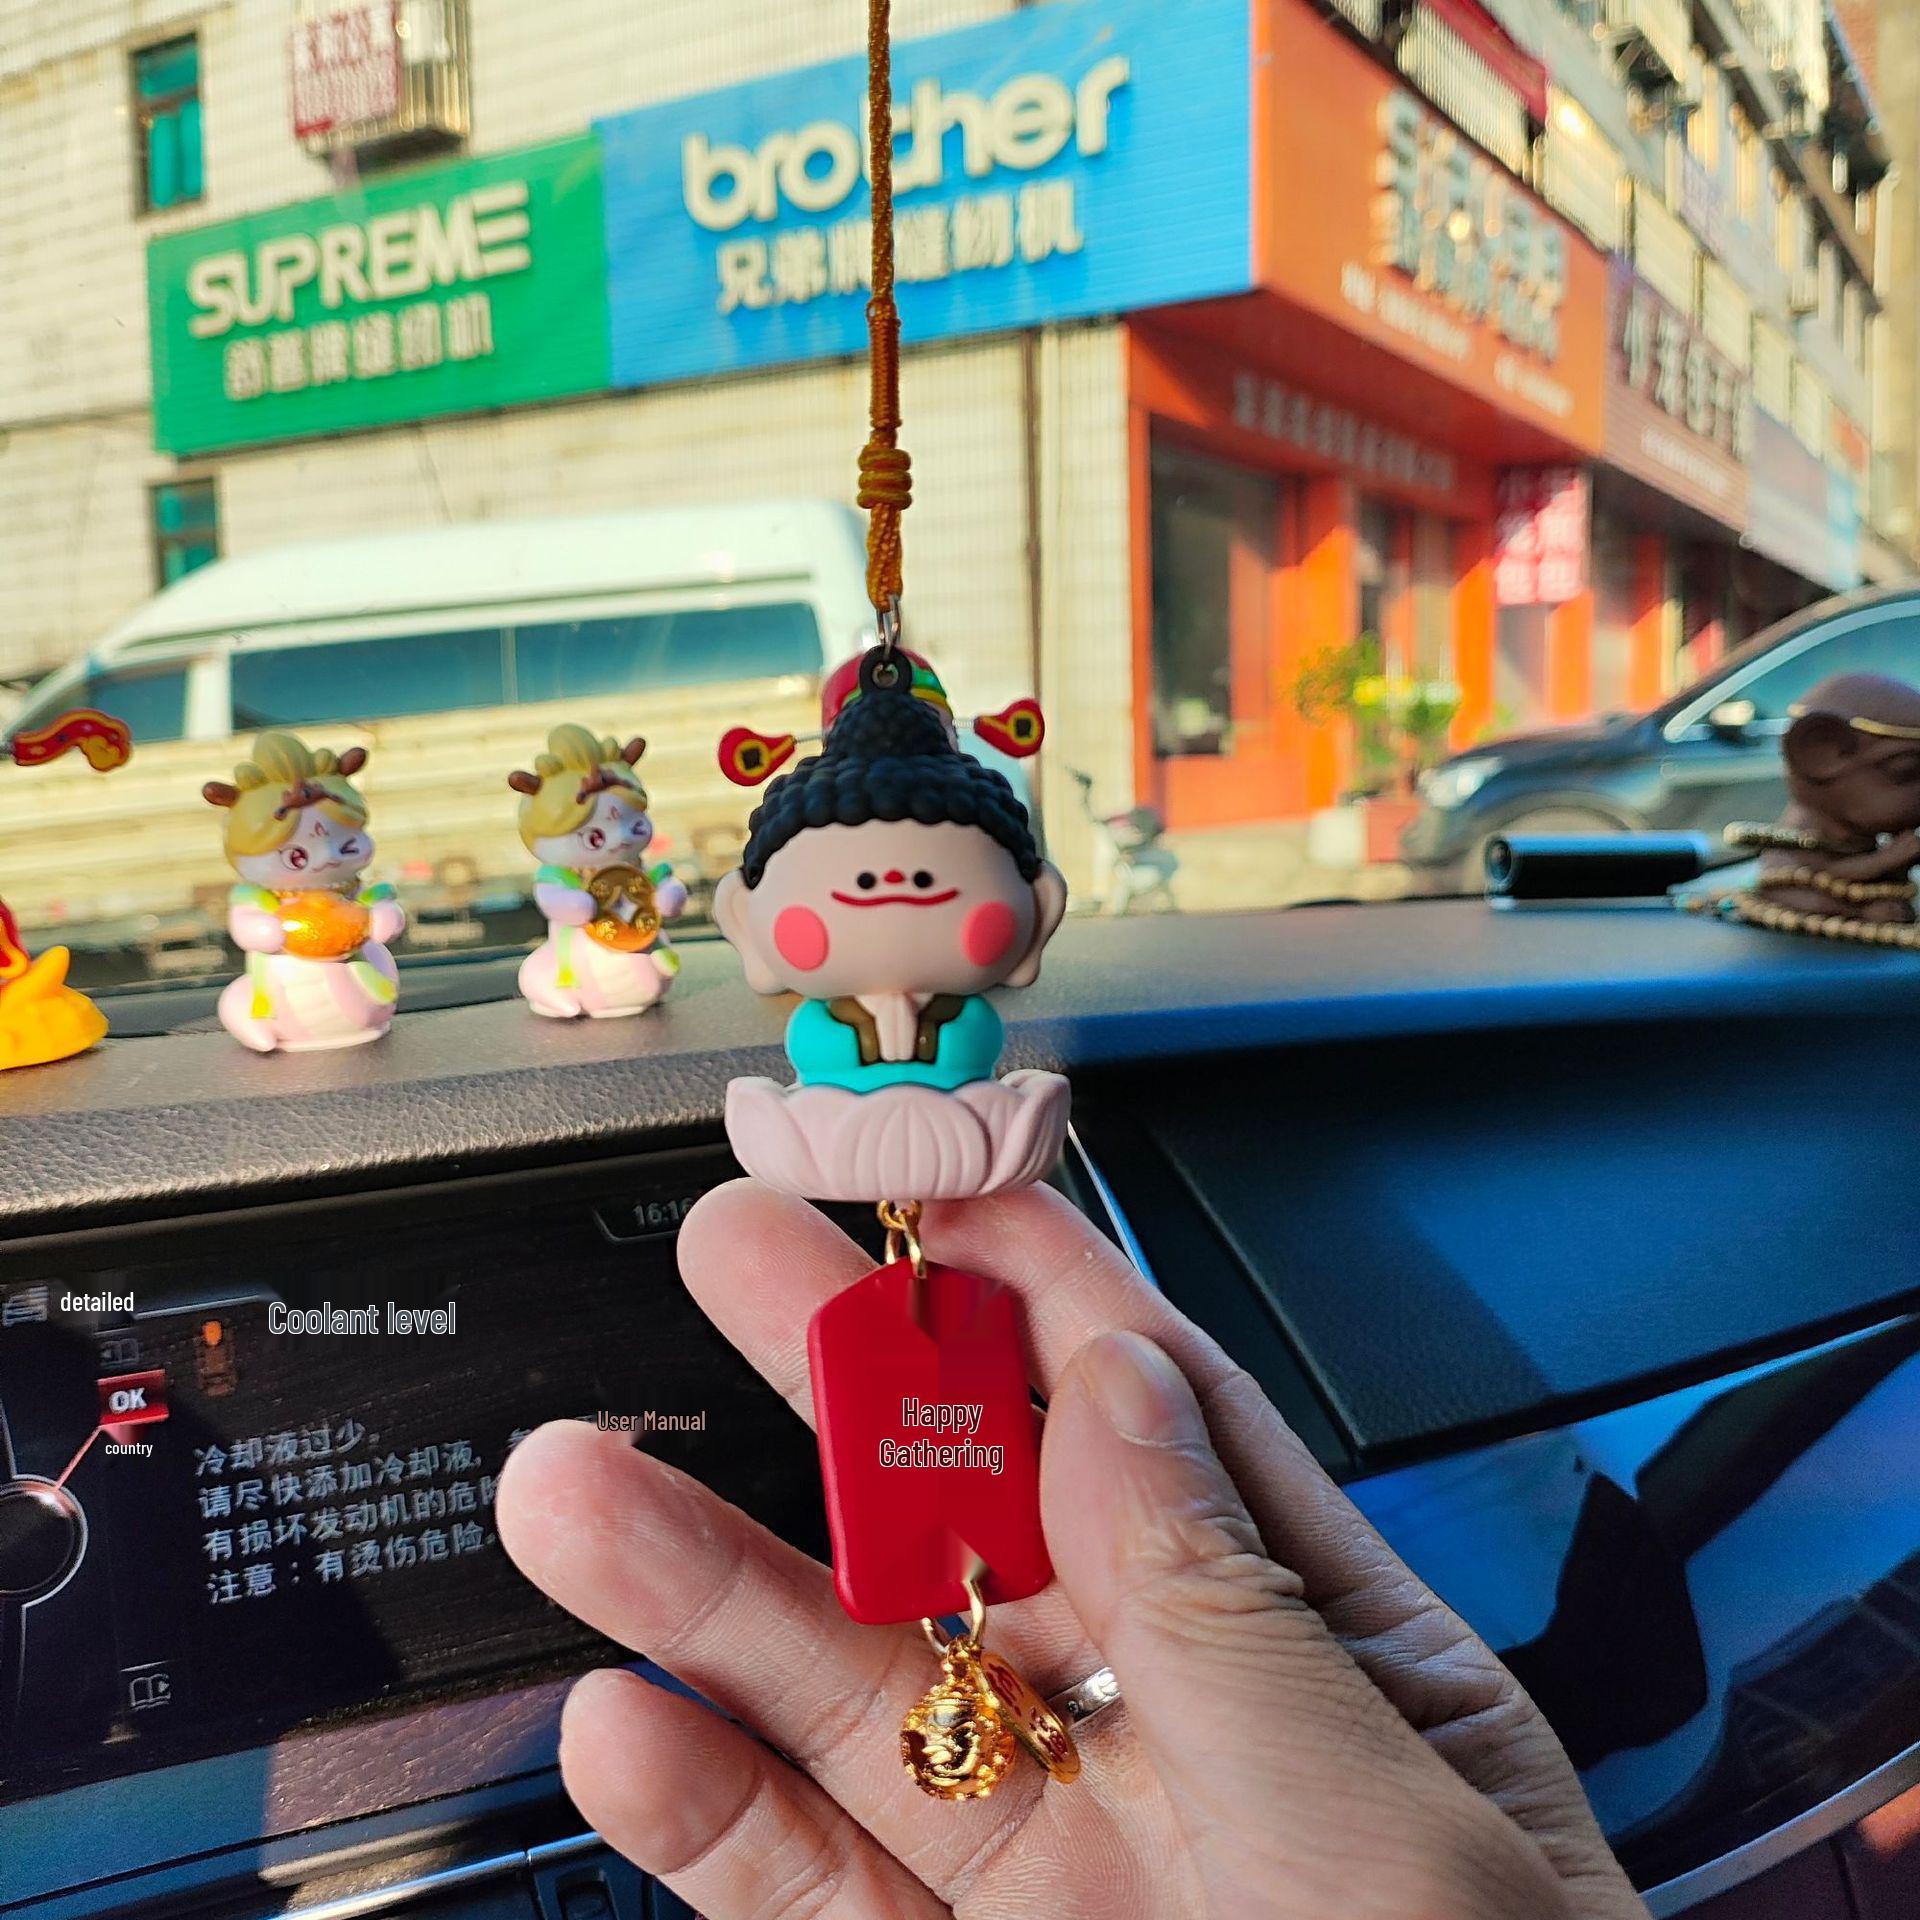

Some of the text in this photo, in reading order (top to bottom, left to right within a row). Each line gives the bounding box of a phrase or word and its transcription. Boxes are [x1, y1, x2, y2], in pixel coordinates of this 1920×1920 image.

[682, 55, 1131, 231] brother
[187, 180, 531, 338] SUPREME
[108, 1386, 148, 1415] OK
